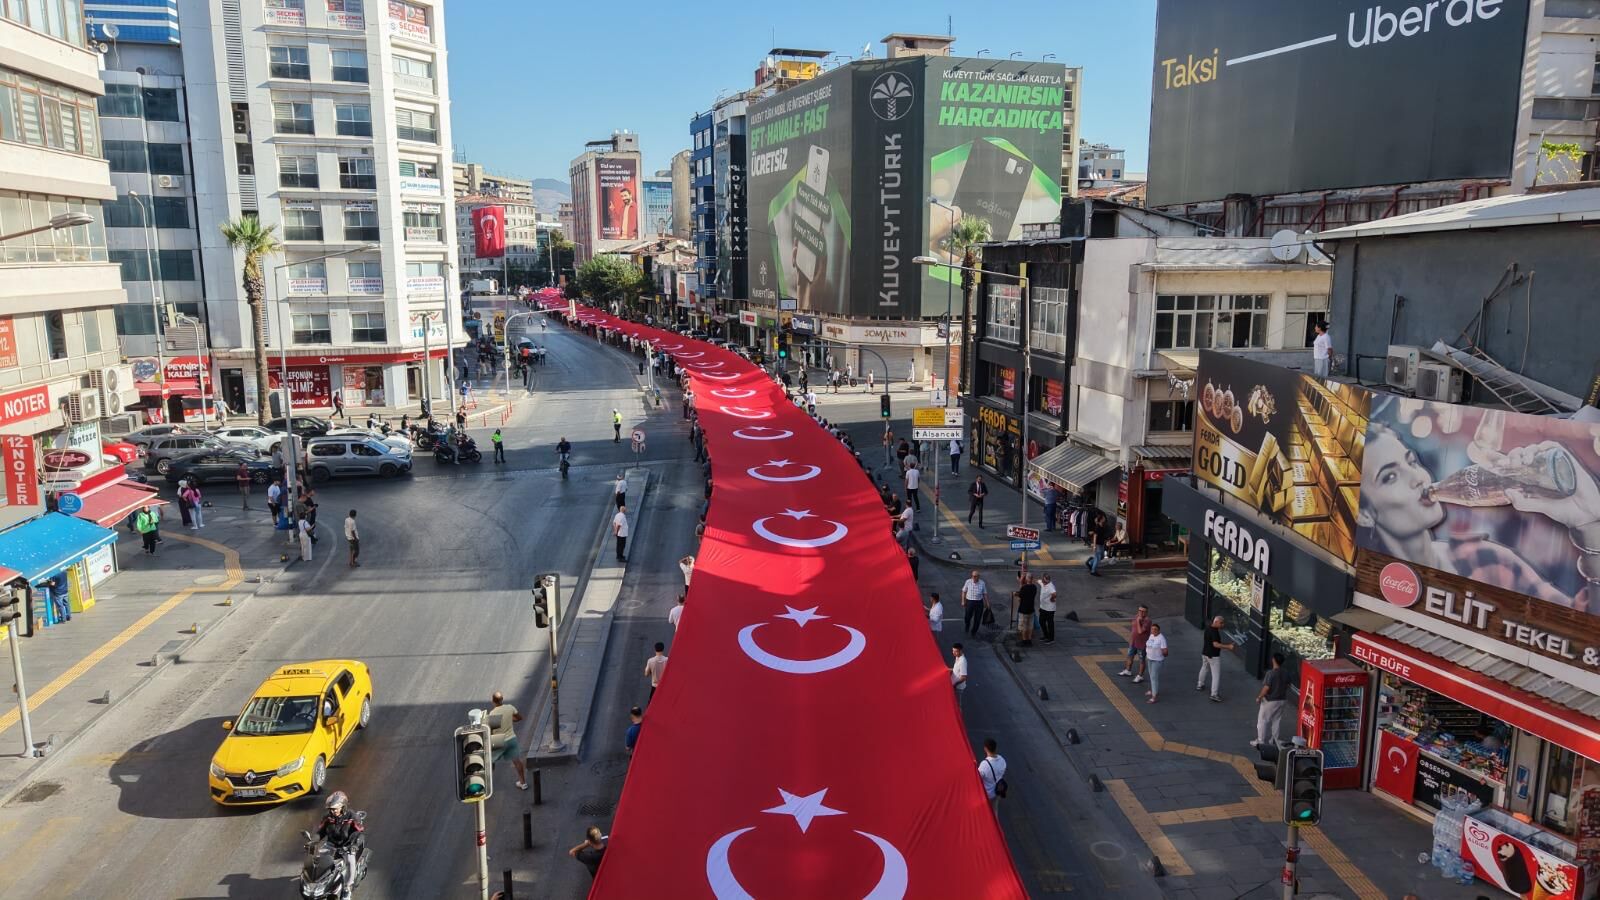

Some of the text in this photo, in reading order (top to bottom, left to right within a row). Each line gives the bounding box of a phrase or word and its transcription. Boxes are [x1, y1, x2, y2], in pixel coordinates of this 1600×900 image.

[943, 69, 974, 79] KUVEYT
[975, 70, 996, 80] TÜRK
[1028, 74, 1061, 85] KART'LA
[1161, 48, 1219, 90] Taksi
[940, 82, 1063, 106] KAZANIRSIN
[767, 113, 801, 146] HAVALE
[804, 103, 830, 135] FAST
[938, 106, 1062, 134] HARCADIKÇA
[751, 147, 788, 177] ÜCRETSİZ
[975, 198, 1012, 219] sağlam
[733, 216, 741, 251] KAYA
[4, 393, 47, 419] NOTER
[290, 397, 316, 405] odafone
[979, 406, 1006, 432] FERDA
[7, 436, 28, 448] 12.
[922, 430, 960, 438] Alsancak
[1200, 428, 1221, 447] FERDA
[12, 448, 29, 504] NOTER
[1198, 445, 1247, 490] GOLD
[1203, 509, 1270, 576] FERDA
[1425, 586, 1496, 630] ELİT
[1502, 619, 1576, 660] TEKEL
[1355, 645, 1411, 677] ELİT BÜFE
[1419, 759, 1451, 778] OBSESSO
